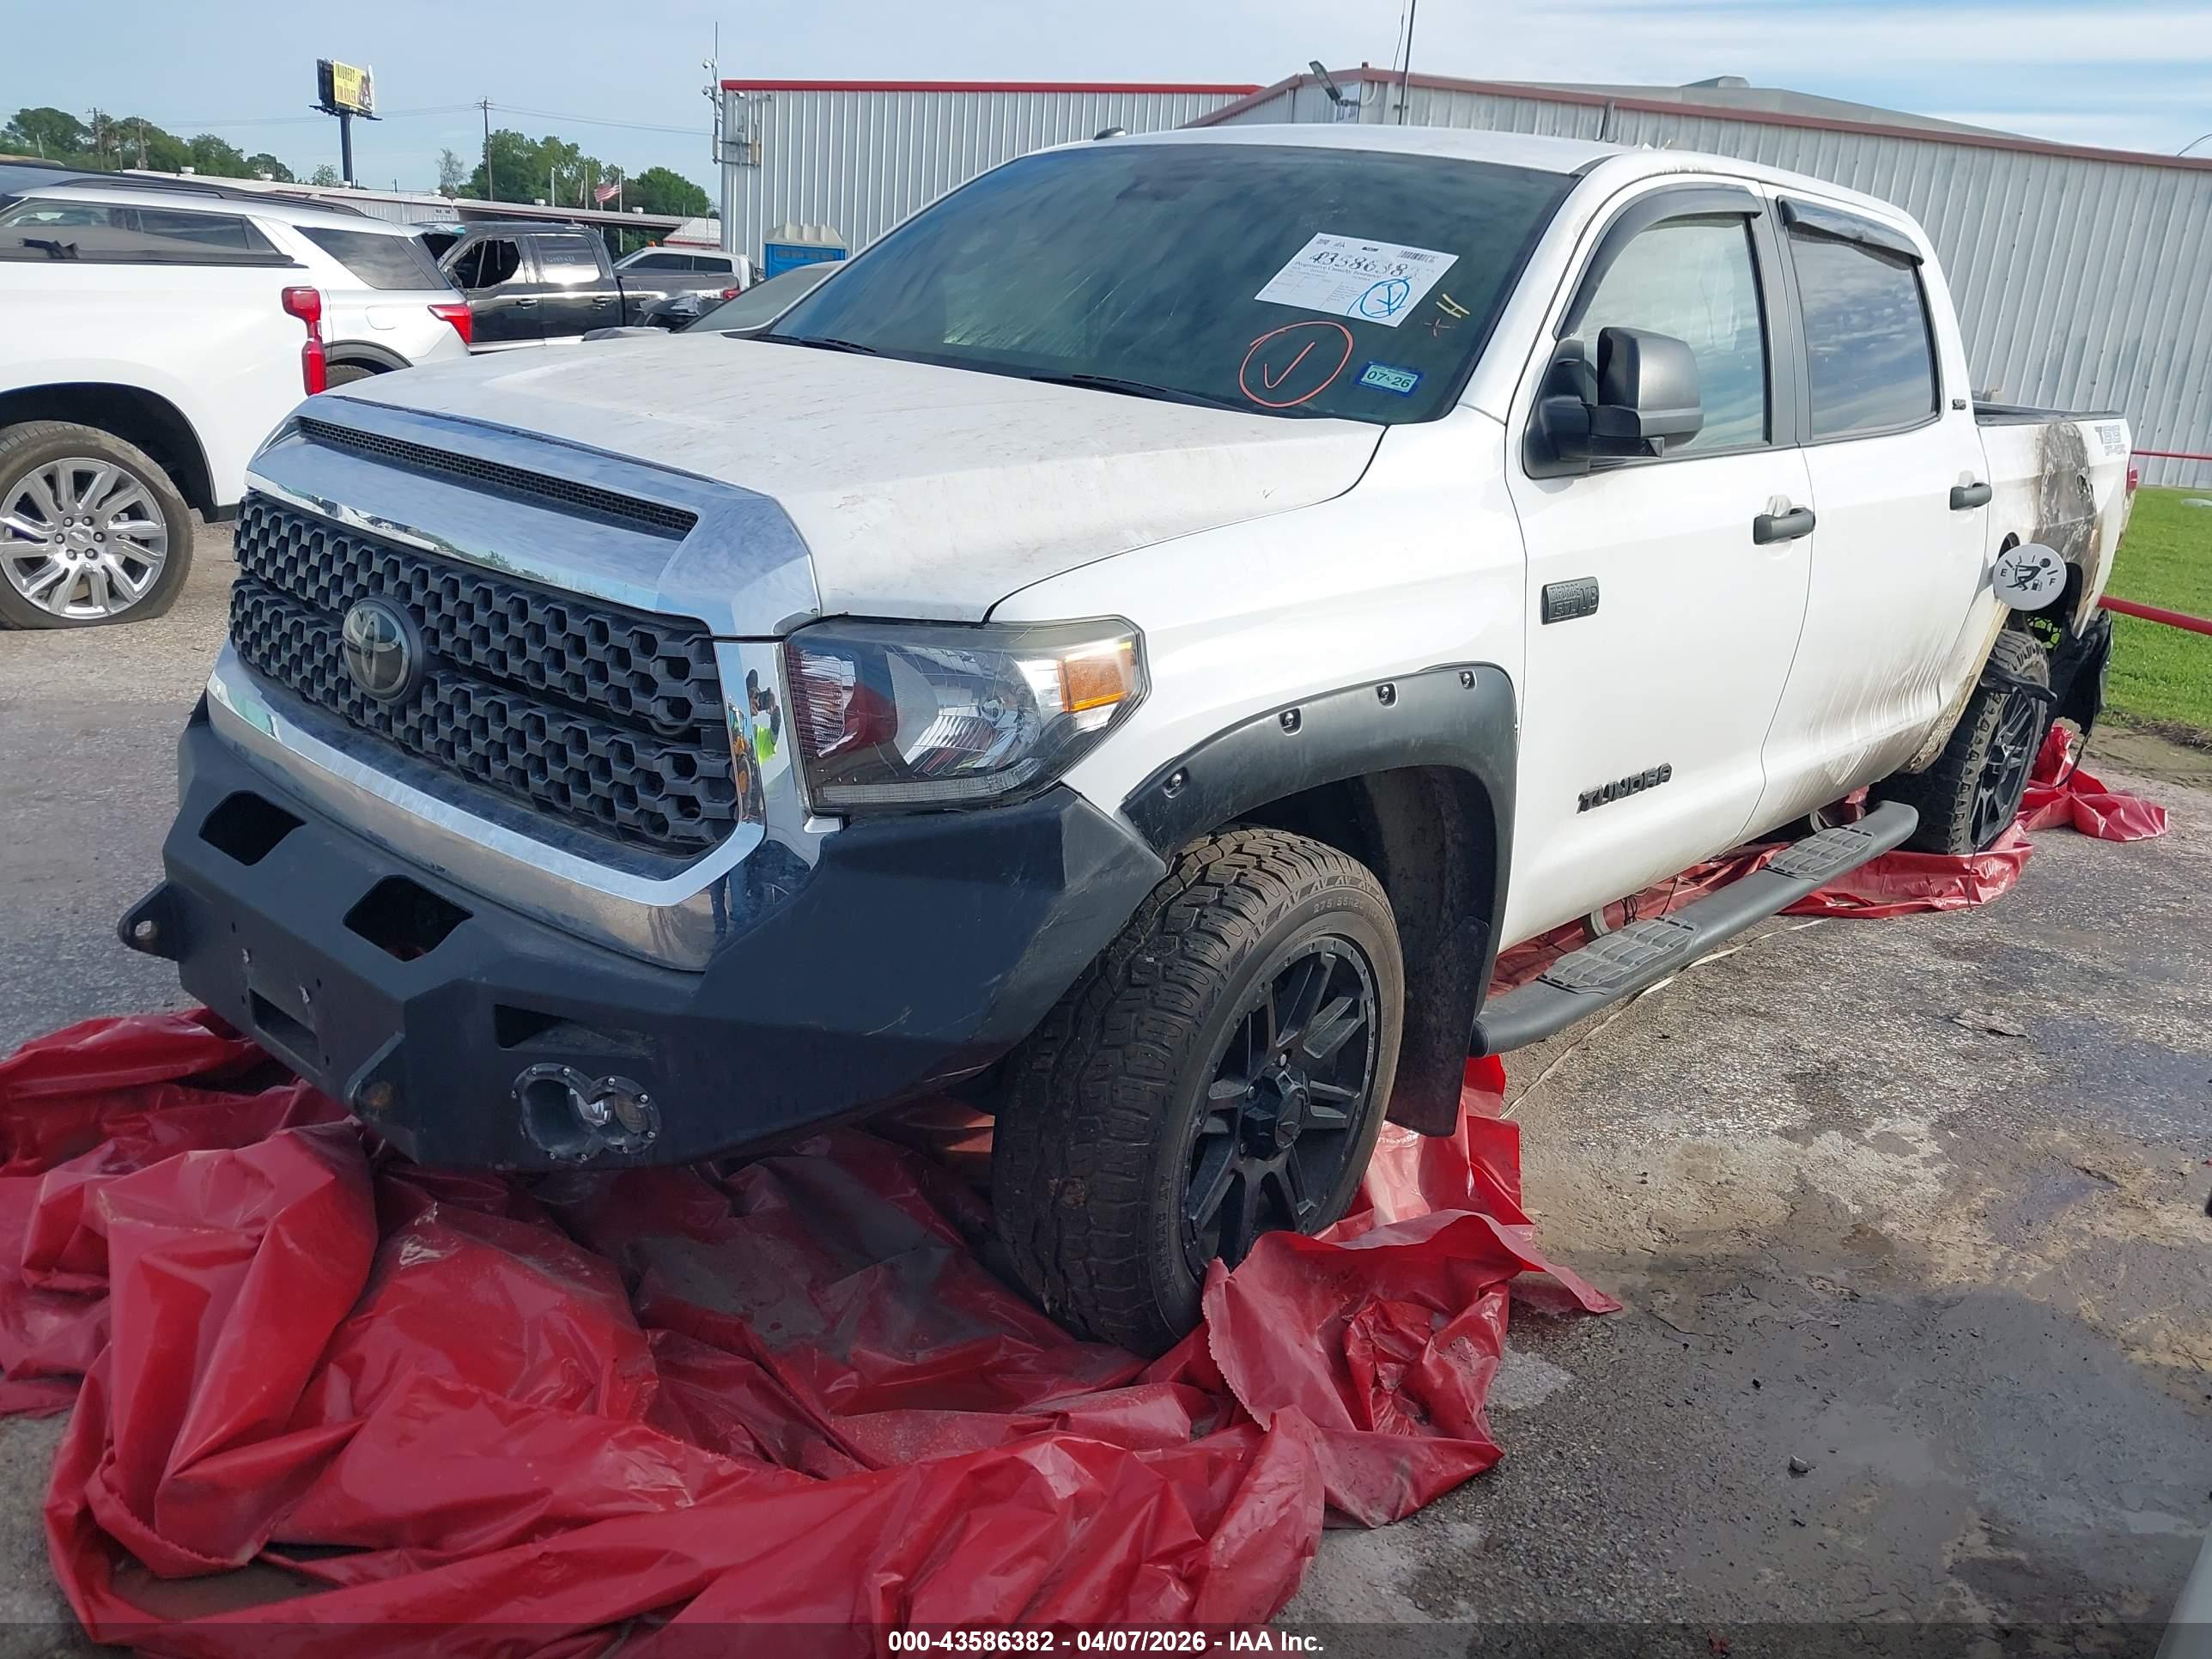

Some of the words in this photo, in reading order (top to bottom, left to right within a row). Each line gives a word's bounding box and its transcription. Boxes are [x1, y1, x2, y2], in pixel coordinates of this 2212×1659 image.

[2000, 568, 2008, 577] E
[2049, 577, 2057, 586] F
[1576, 763, 1673, 814] TUNDRA
